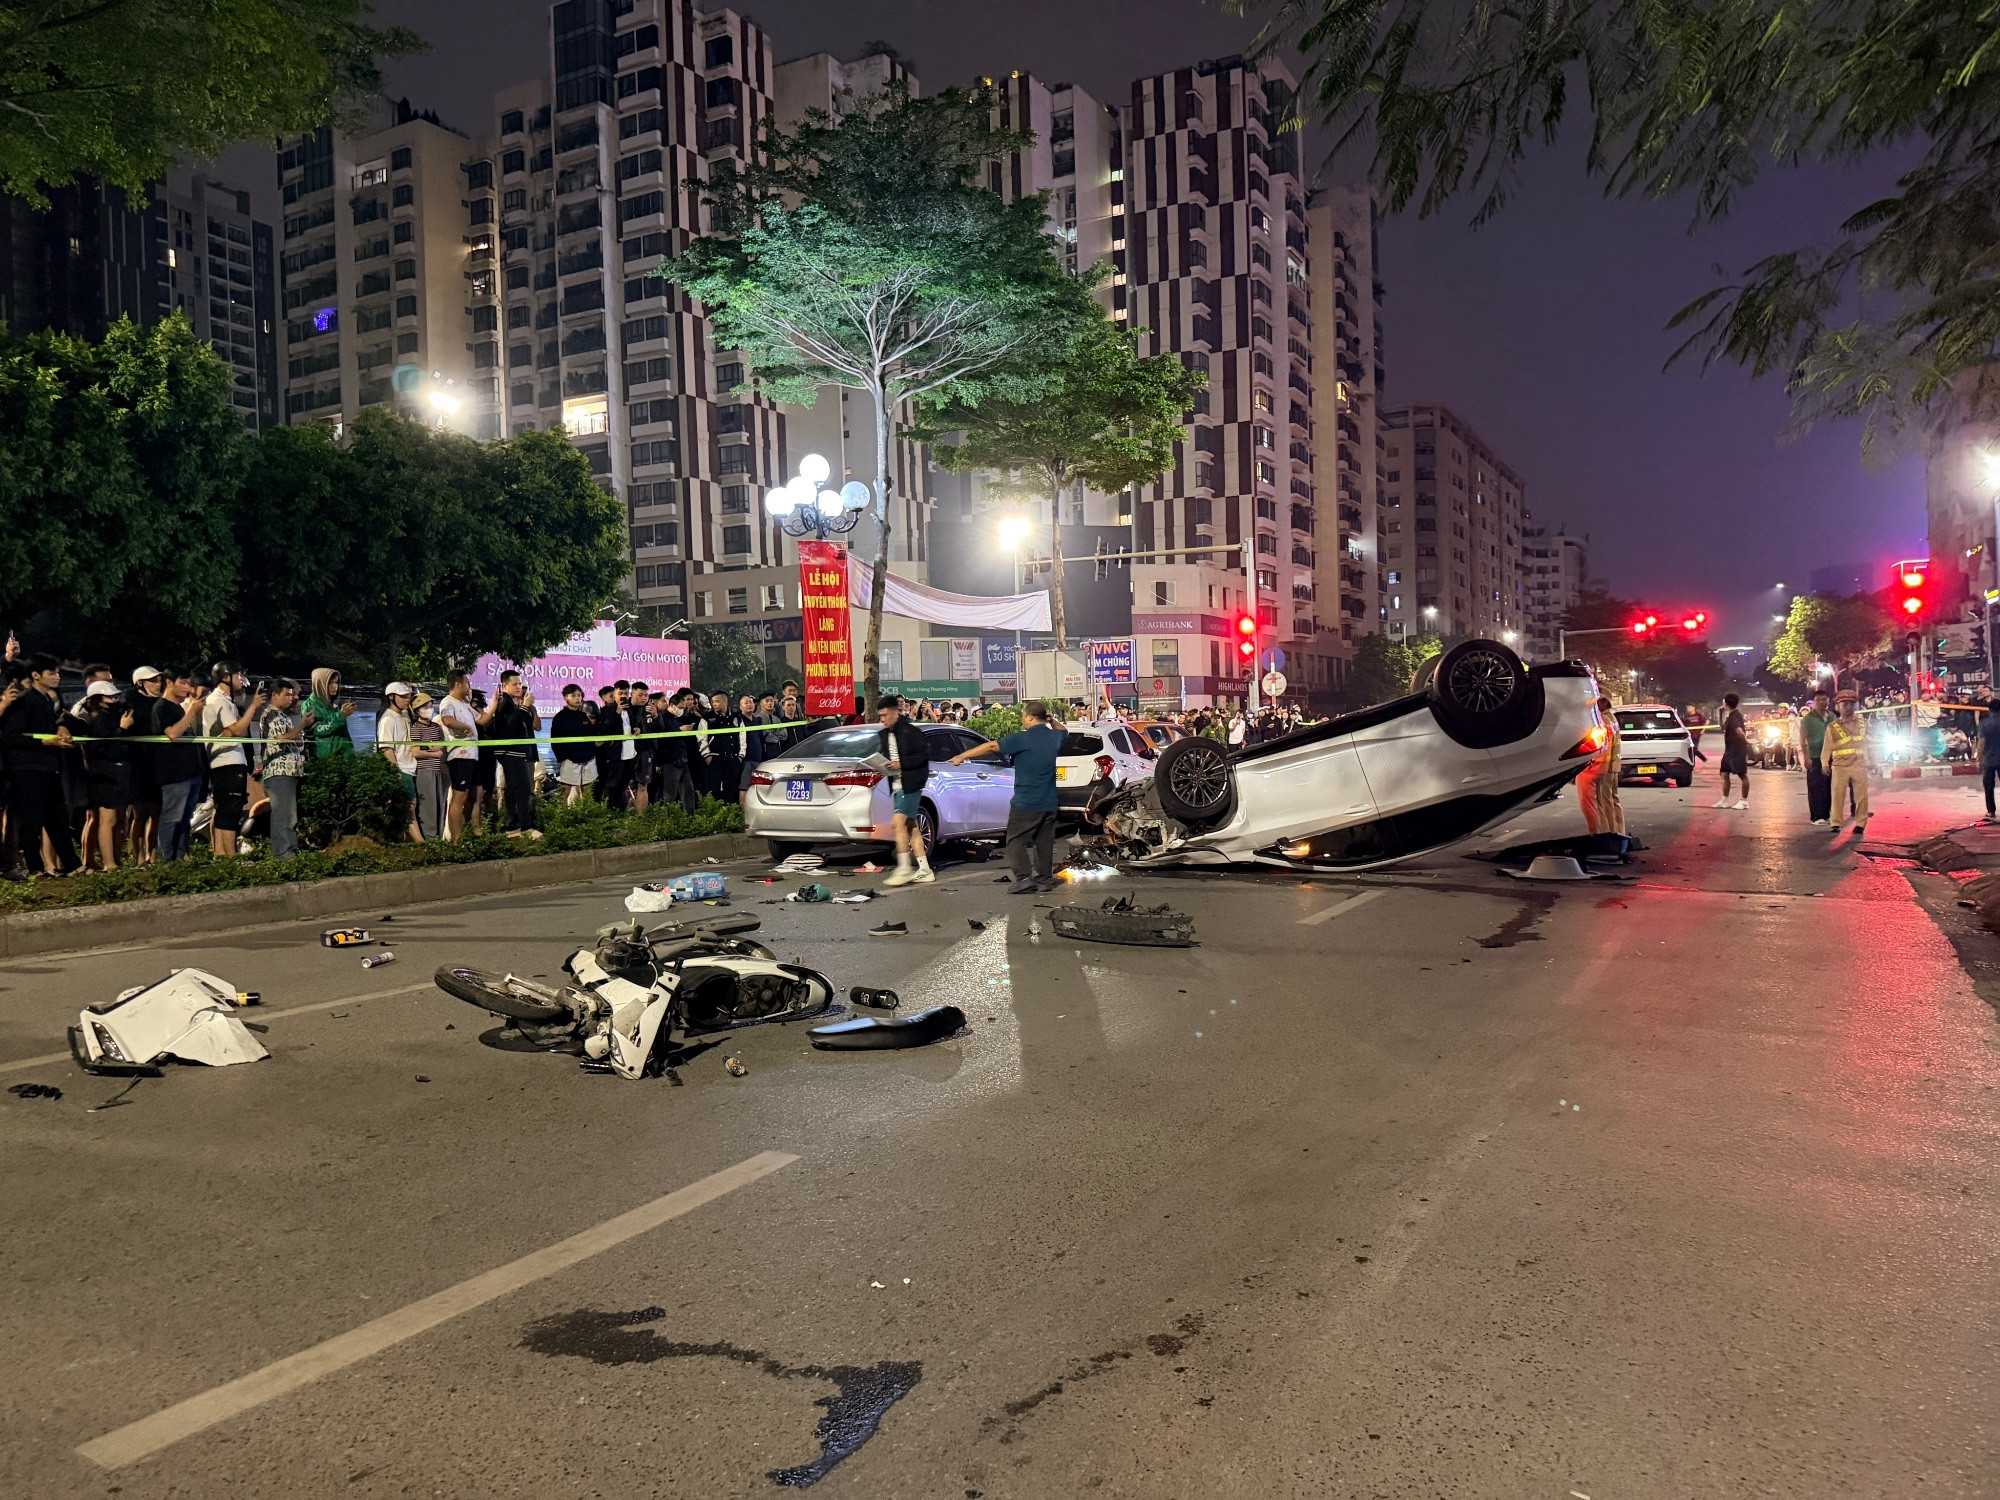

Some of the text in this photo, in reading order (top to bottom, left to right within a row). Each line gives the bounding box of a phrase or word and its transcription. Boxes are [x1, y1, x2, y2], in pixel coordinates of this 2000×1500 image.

[809, 568, 840, 588] LỄ HỘI
[819, 615, 835, 631] LÀNG
[1147, 621, 1193, 629] AGRIBANK
[1094, 642, 1129, 655] VNVC
[632, 649, 654, 663] GÒN
[656, 653, 688, 664] MOTOR
[548, 664, 594, 679] MOTOR
[1218, 681, 1248, 692] HIGHLANDS
[819, 698, 842, 707] 2026
[791, 781, 805, 790] 29A
